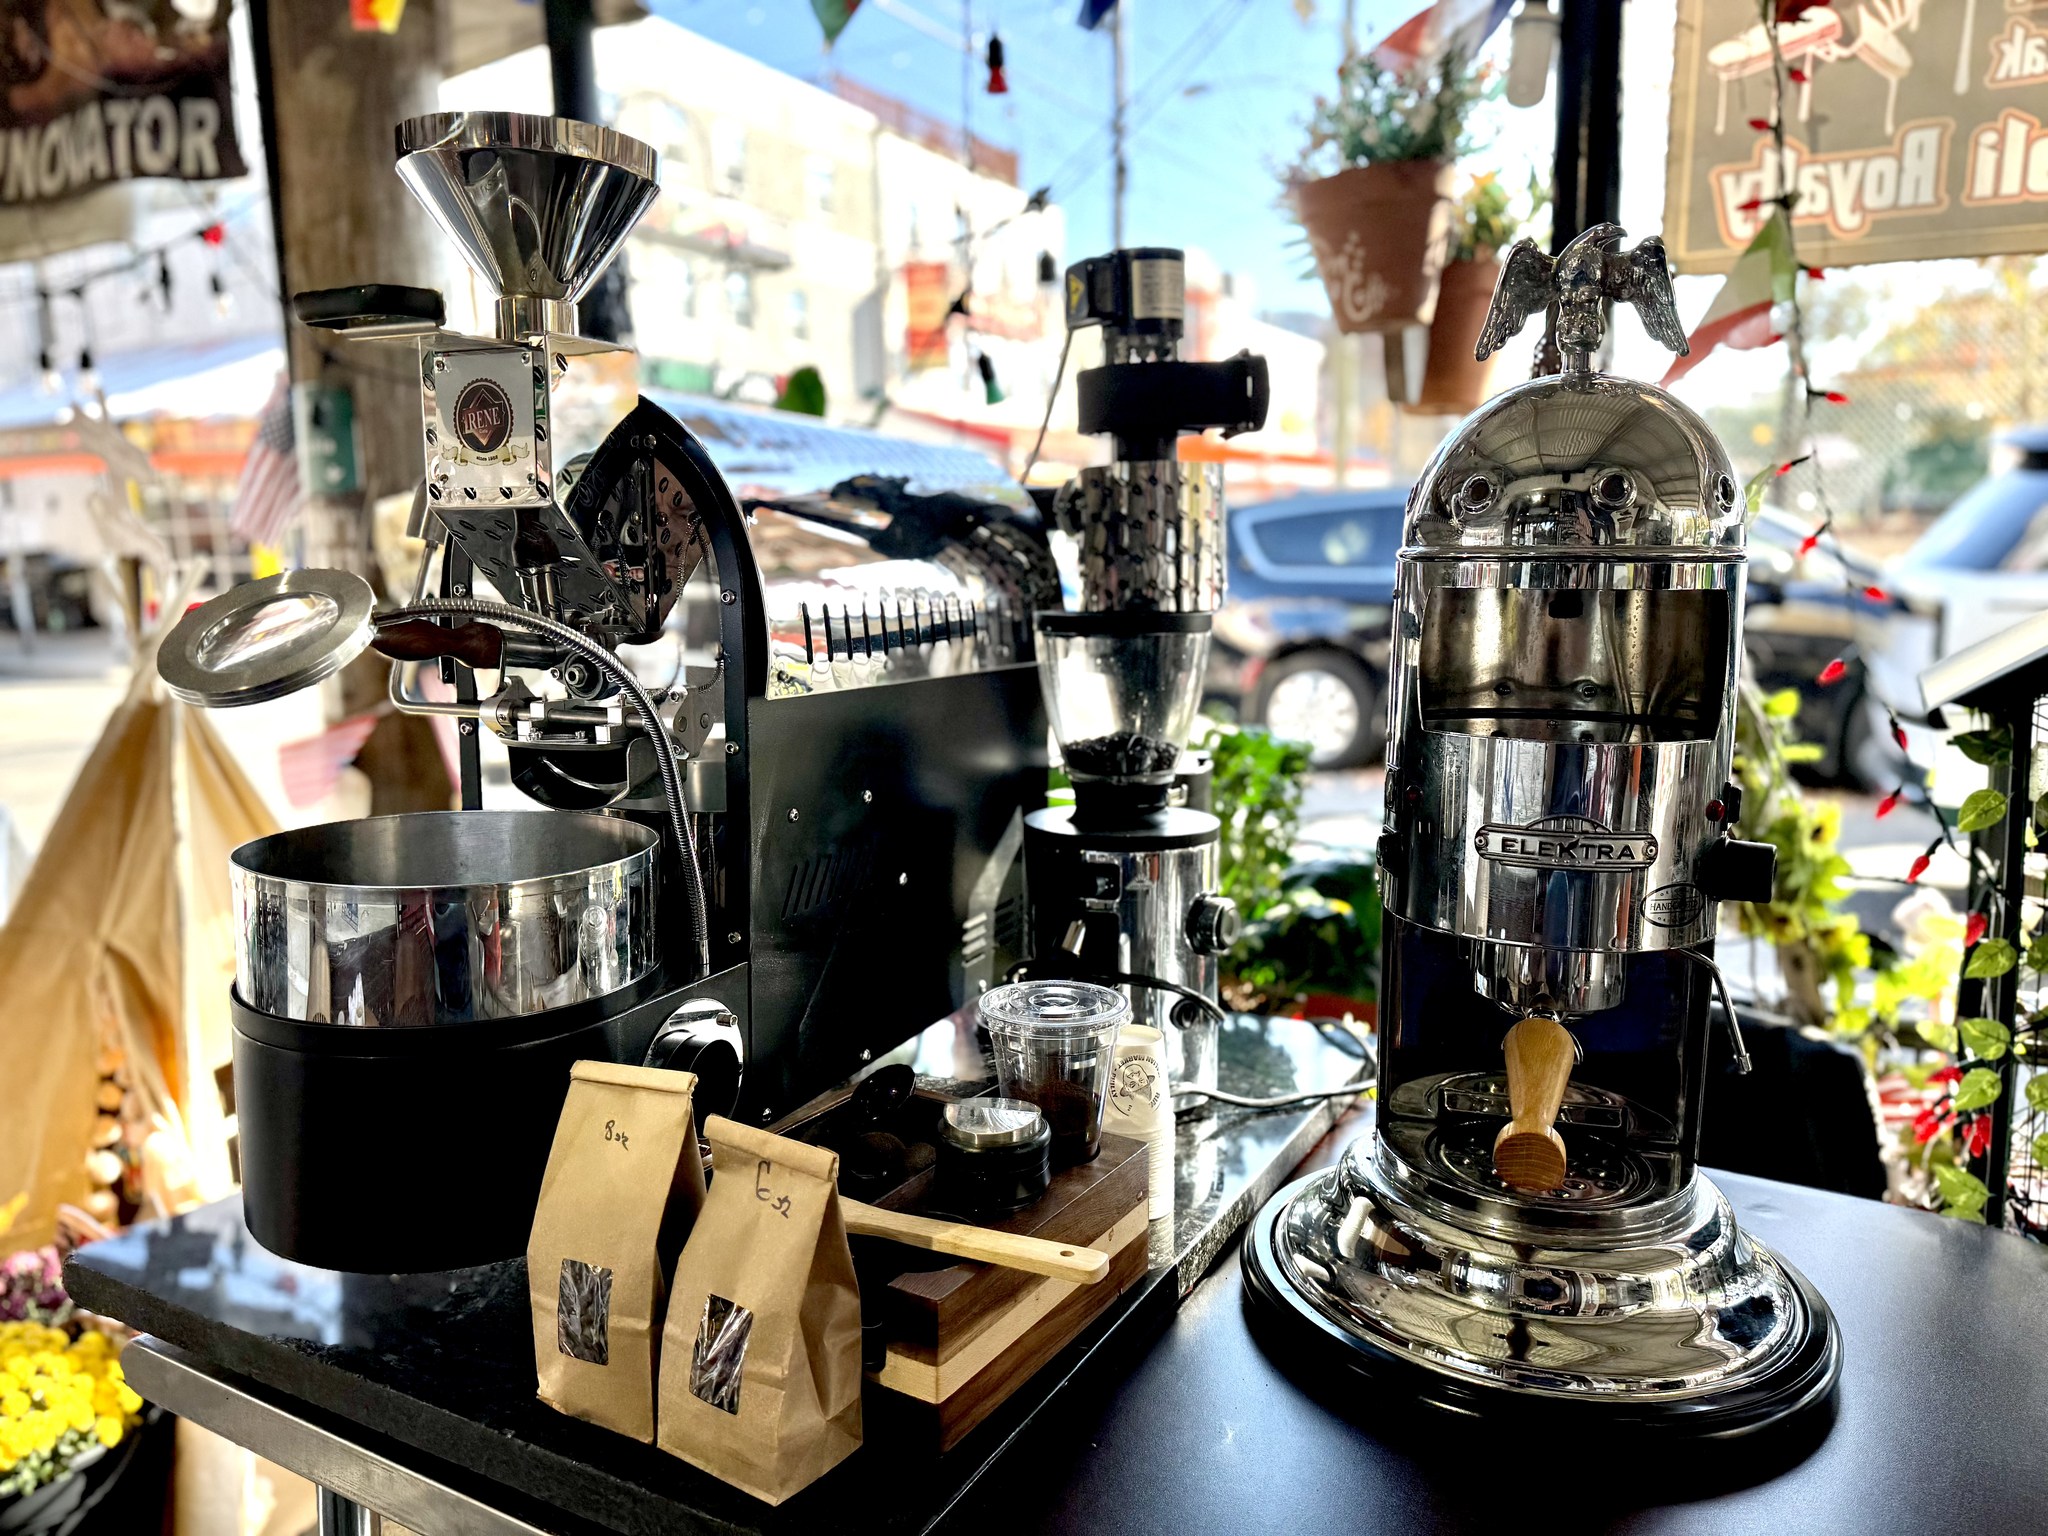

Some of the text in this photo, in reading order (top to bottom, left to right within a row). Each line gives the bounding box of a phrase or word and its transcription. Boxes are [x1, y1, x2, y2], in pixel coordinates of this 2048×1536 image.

[0, 95, 221, 199] NOVATOR
[463, 406, 501, 432] IRENE
[1501, 837, 1636, 860] ELEKTRA
[1118, 1055, 1145, 1069] MARKET
